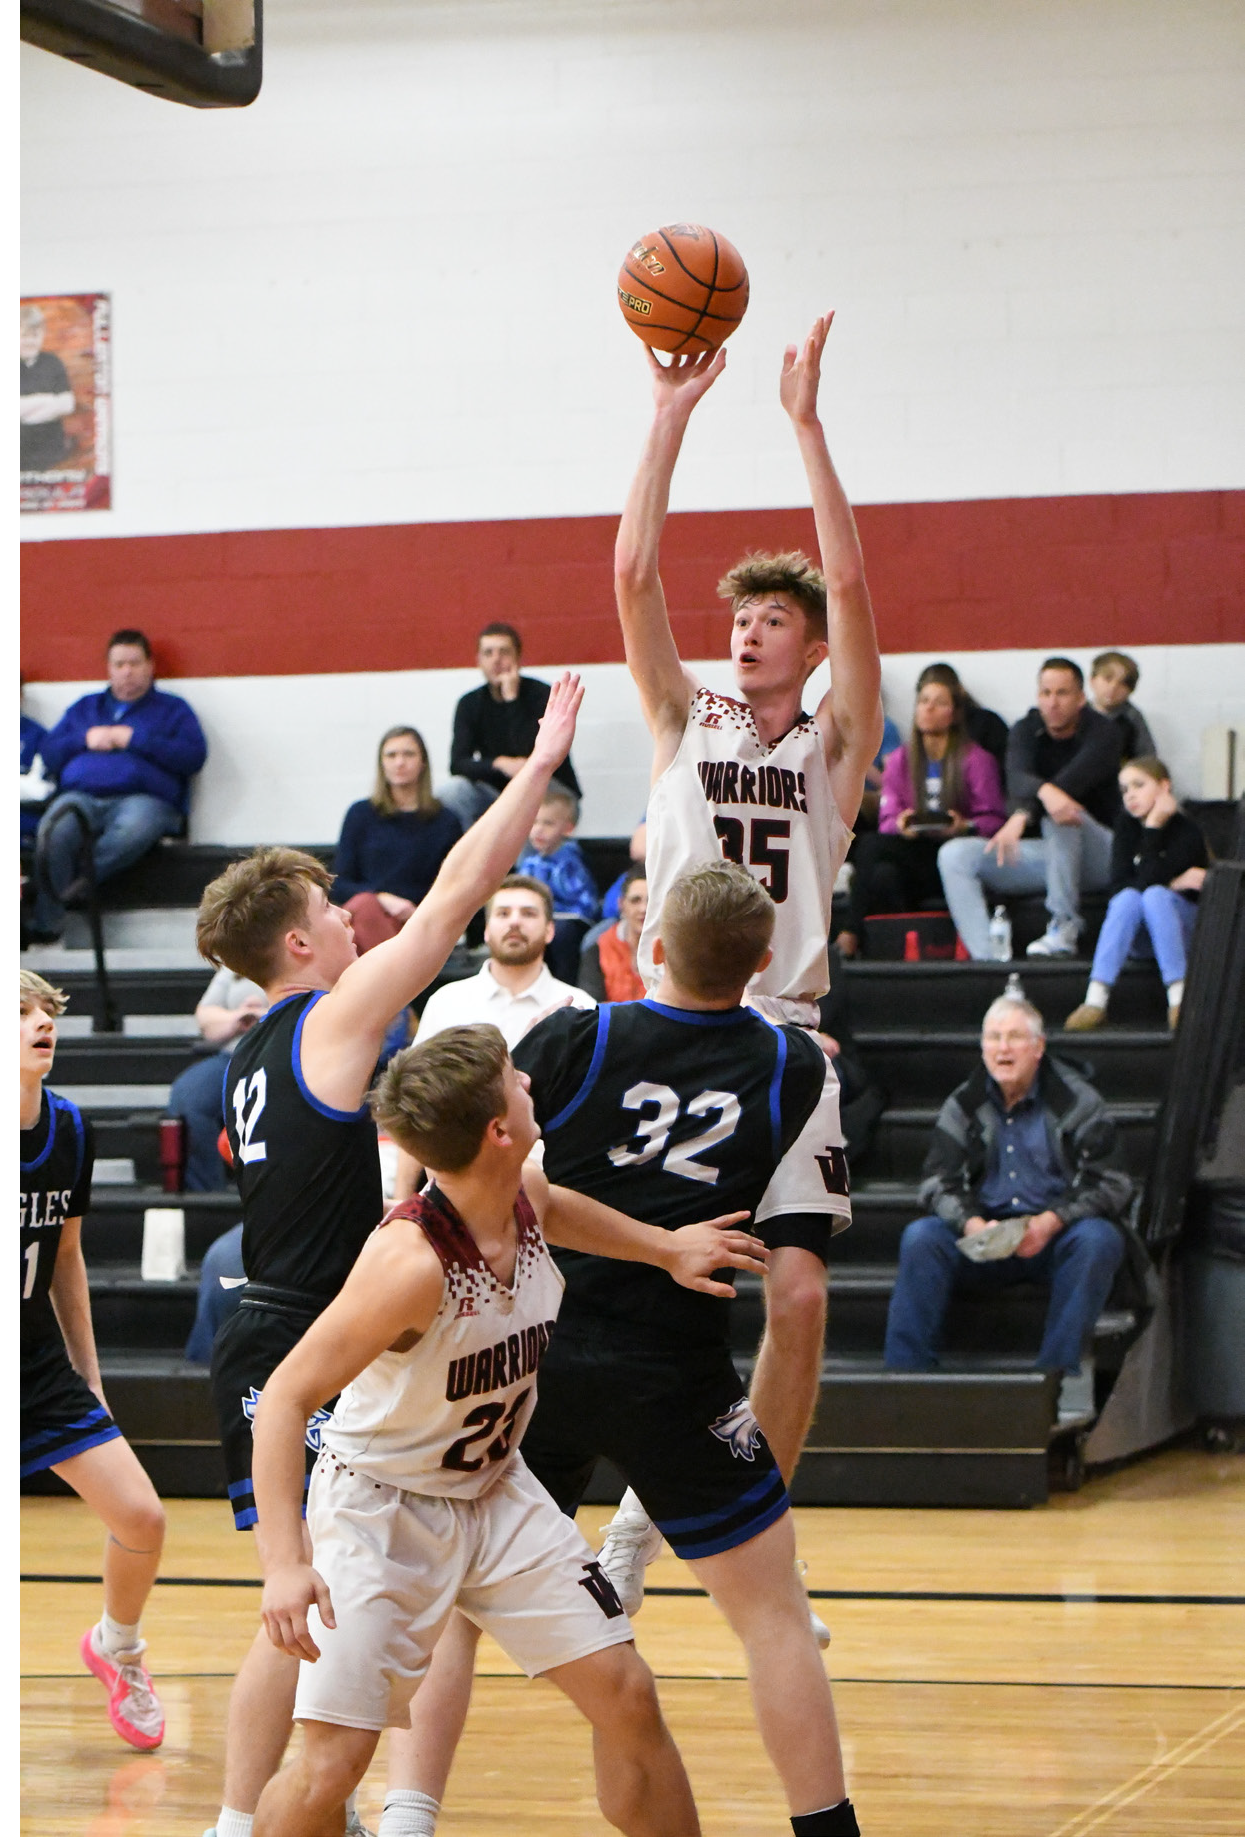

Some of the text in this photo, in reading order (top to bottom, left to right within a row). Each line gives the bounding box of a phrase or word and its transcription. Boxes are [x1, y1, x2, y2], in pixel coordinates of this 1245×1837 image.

[628, 295, 652, 316] PRO
[232, 1065, 267, 1166] 12
[607, 1080, 742, 1186] 32
